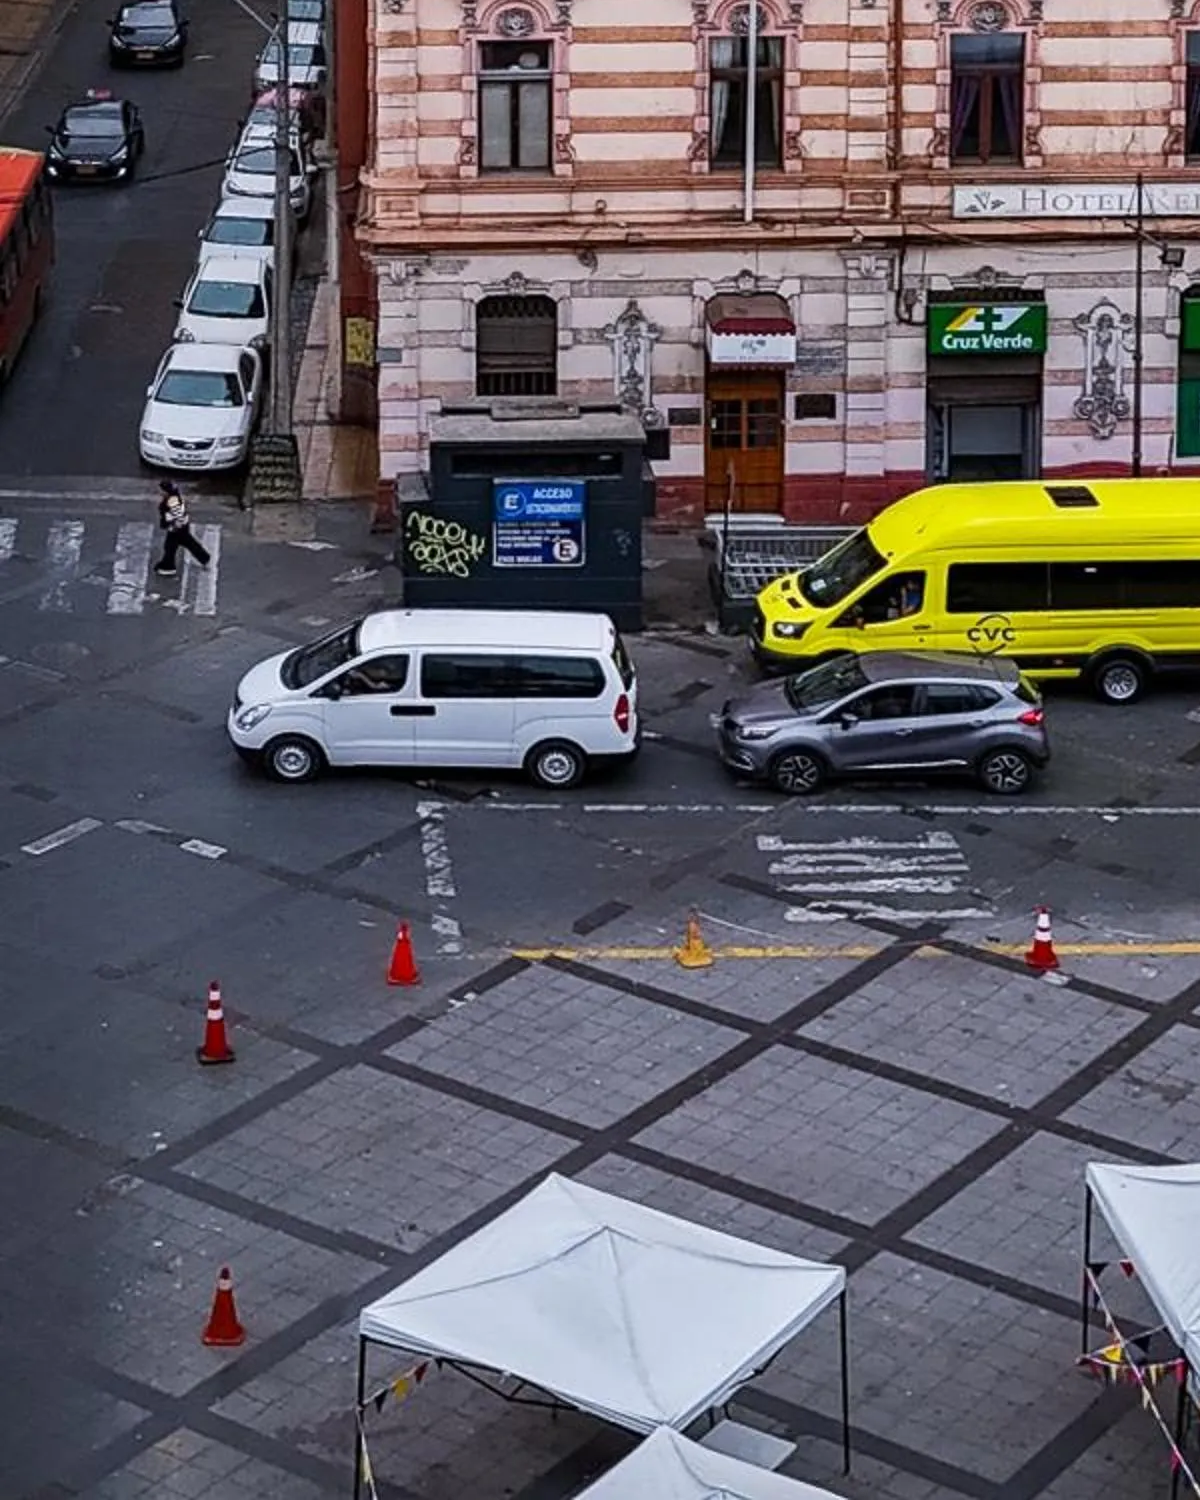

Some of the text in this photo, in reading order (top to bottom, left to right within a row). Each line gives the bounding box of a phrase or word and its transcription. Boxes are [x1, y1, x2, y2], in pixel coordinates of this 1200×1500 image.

[1020, 188, 1129, 212] HOTEL
[941, 332, 1034, 350] Cruz Verde
[532, 487, 574, 499] ACCESO
[967, 627, 1016, 642] CVC
